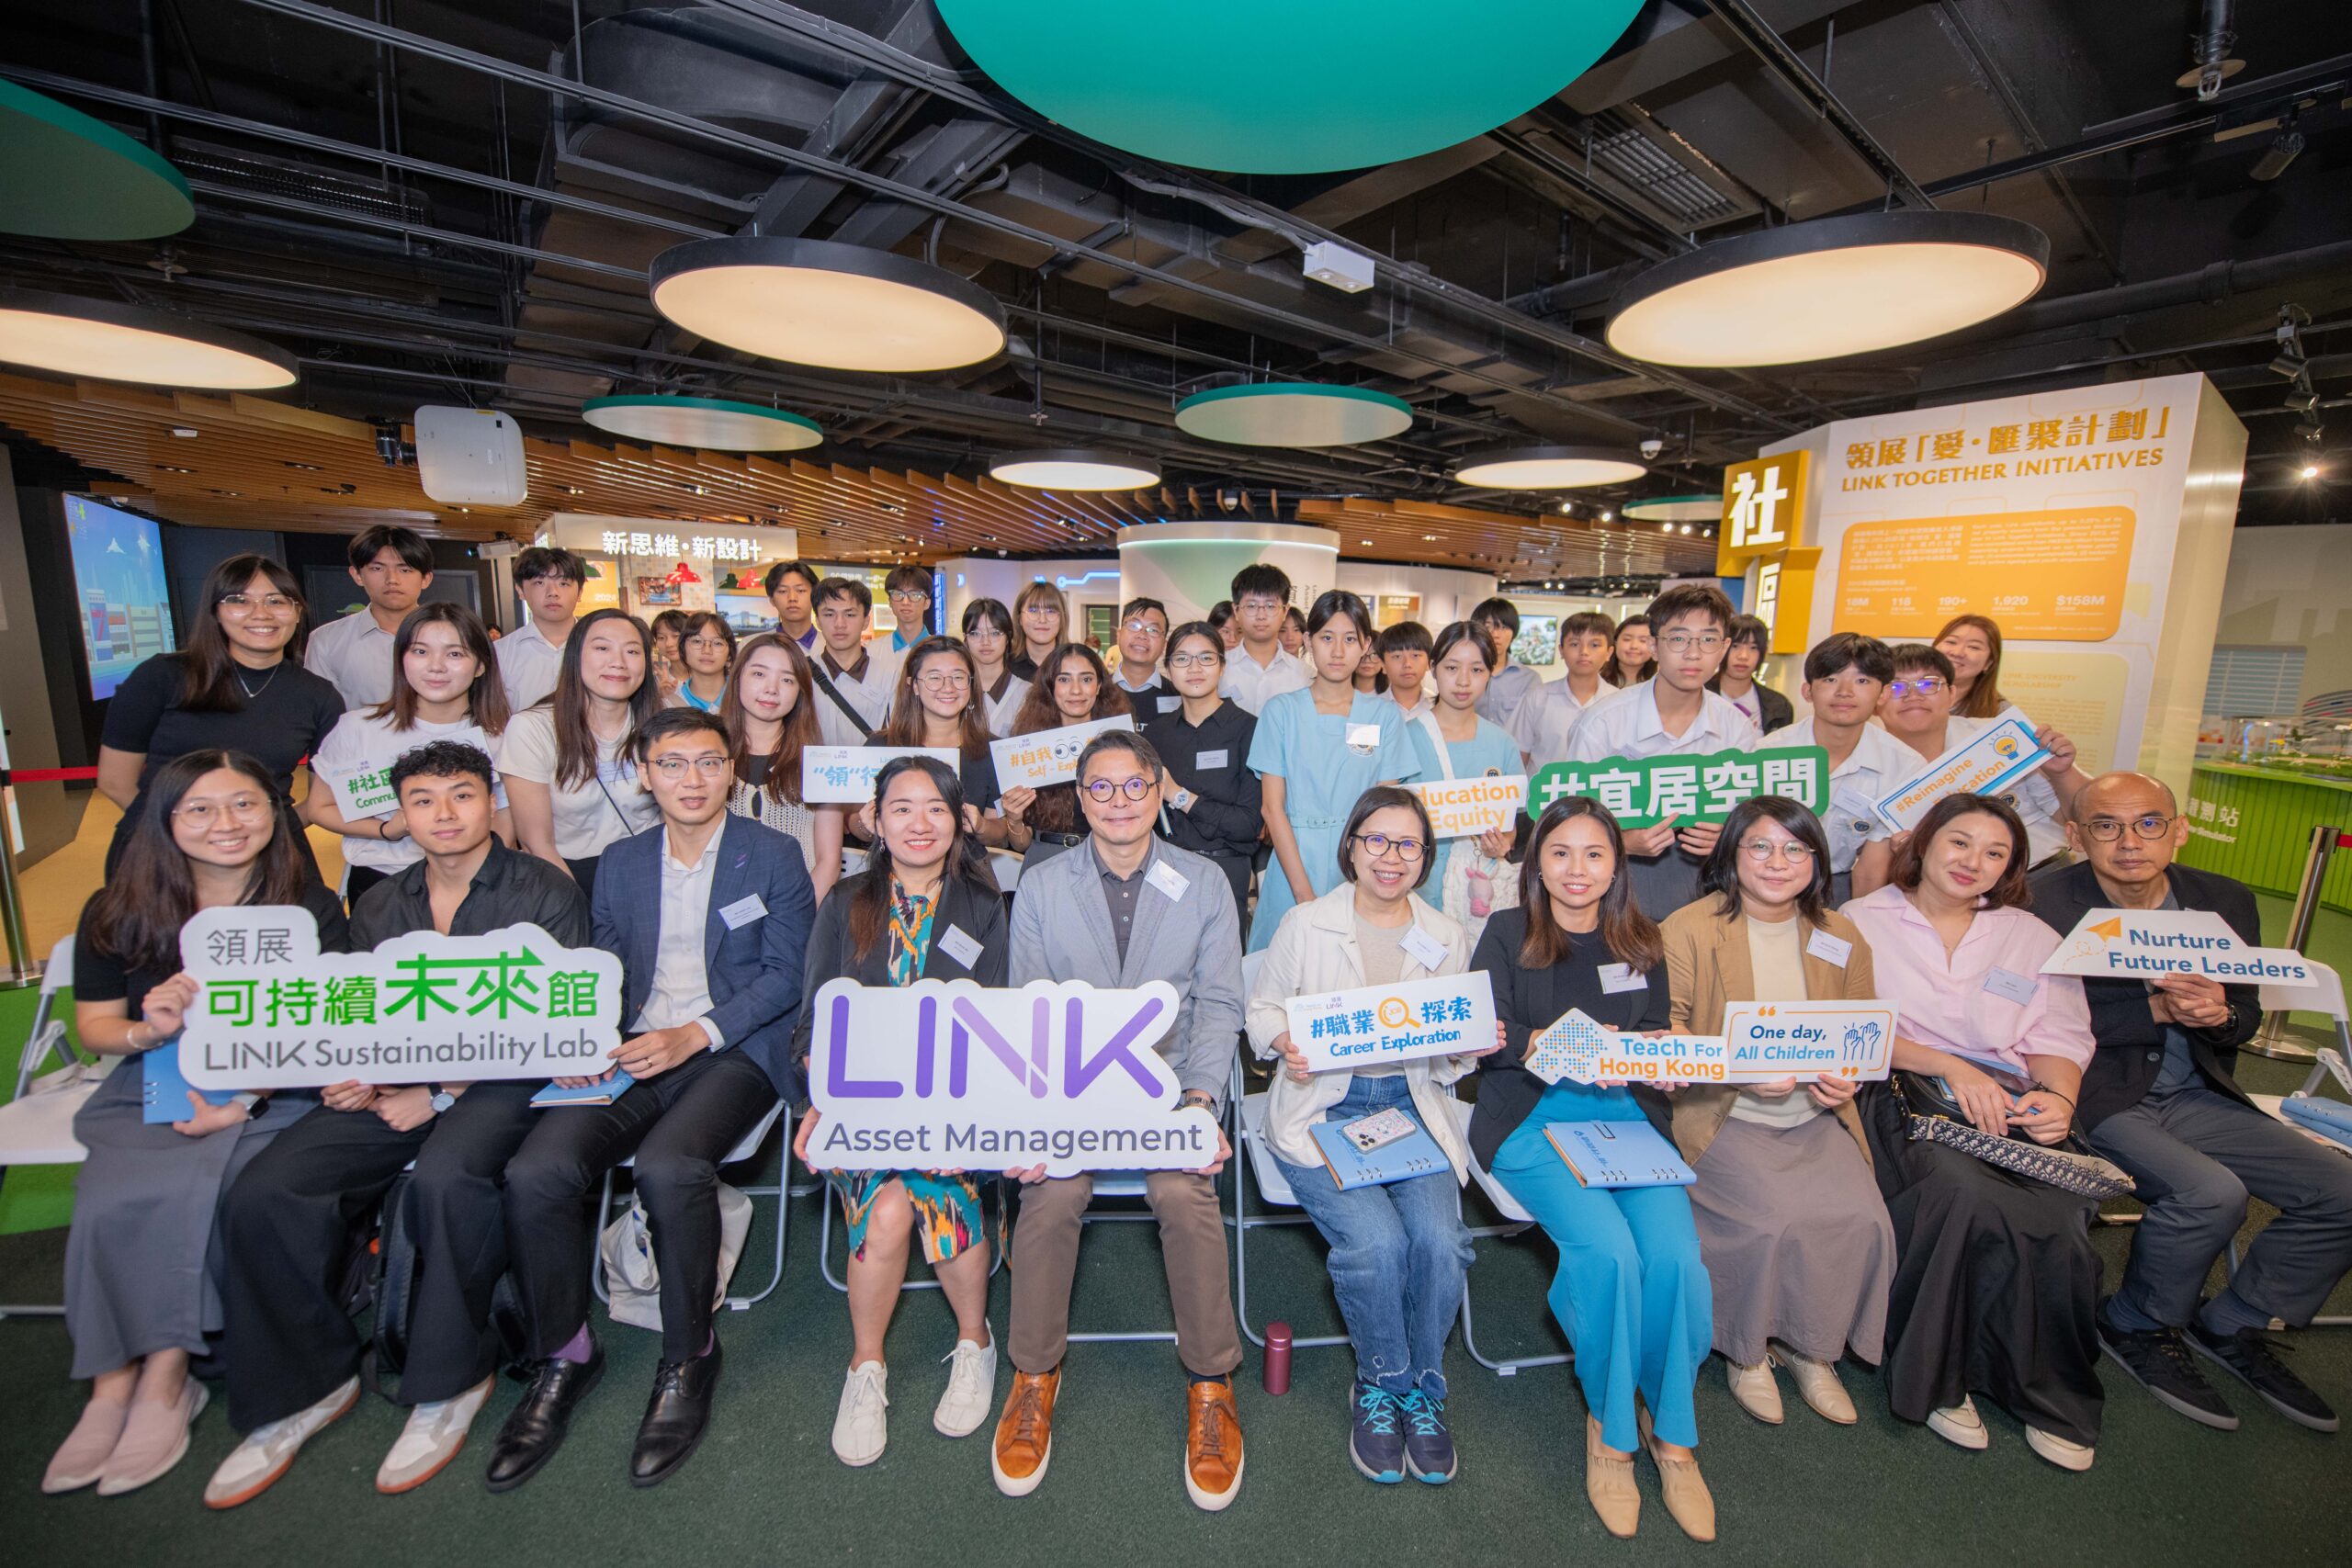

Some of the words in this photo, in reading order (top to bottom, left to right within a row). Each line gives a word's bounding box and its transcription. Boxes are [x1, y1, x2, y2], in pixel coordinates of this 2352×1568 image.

[1841, 474, 1888, 492] LINK
[1893, 463, 2007, 488] TOGETHER
[2015, 447, 2164, 477] INITIATIVES
[1939, 596, 1968, 606] 190+
[2056, 595, 2106, 606] $158M
[1028, 763, 1046, 778] Self
[1416, 782, 1520, 807] ducation
[1895, 758, 1974, 813] #Reimagine
[1427, 806, 1507, 833] Equity
[207, 928, 293, 966] 領展
[2129, 929, 2232, 950] Nurture
[2108, 952, 2193, 972] Future
[2202, 957, 2306, 978] Leaders
[206, 944, 600, 1028] 可持續未來館
[1310, 1010, 1374, 1039] #職業
[1420, 997, 1472, 1024] 探索
[827, 995, 1164, 1099] LINK
[1329, 1041, 1376, 1056] Career
[1381, 1029, 1461, 1052] Exploration
[1749, 1026, 1786, 1040] One
[1792, 1025, 1826, 1042] day,
[206, 1040, 307, 1070] LINK
[314, 1032, 537, 1066] Sustainability
[543, 1029, 598, 1058] Lab
[1620, 1039, 1687, 1057] Teach
[1735, 1046, 1758, 1060] All
[1763, 1045, 1835, 1060] Children
[1600, 1058, 1657, 1079] Hong
[1666, 1059, 1725, 1080] Kong
[824, 1122, 931, 1152] Asset
[944, 1123, 1203, 1159] Management
